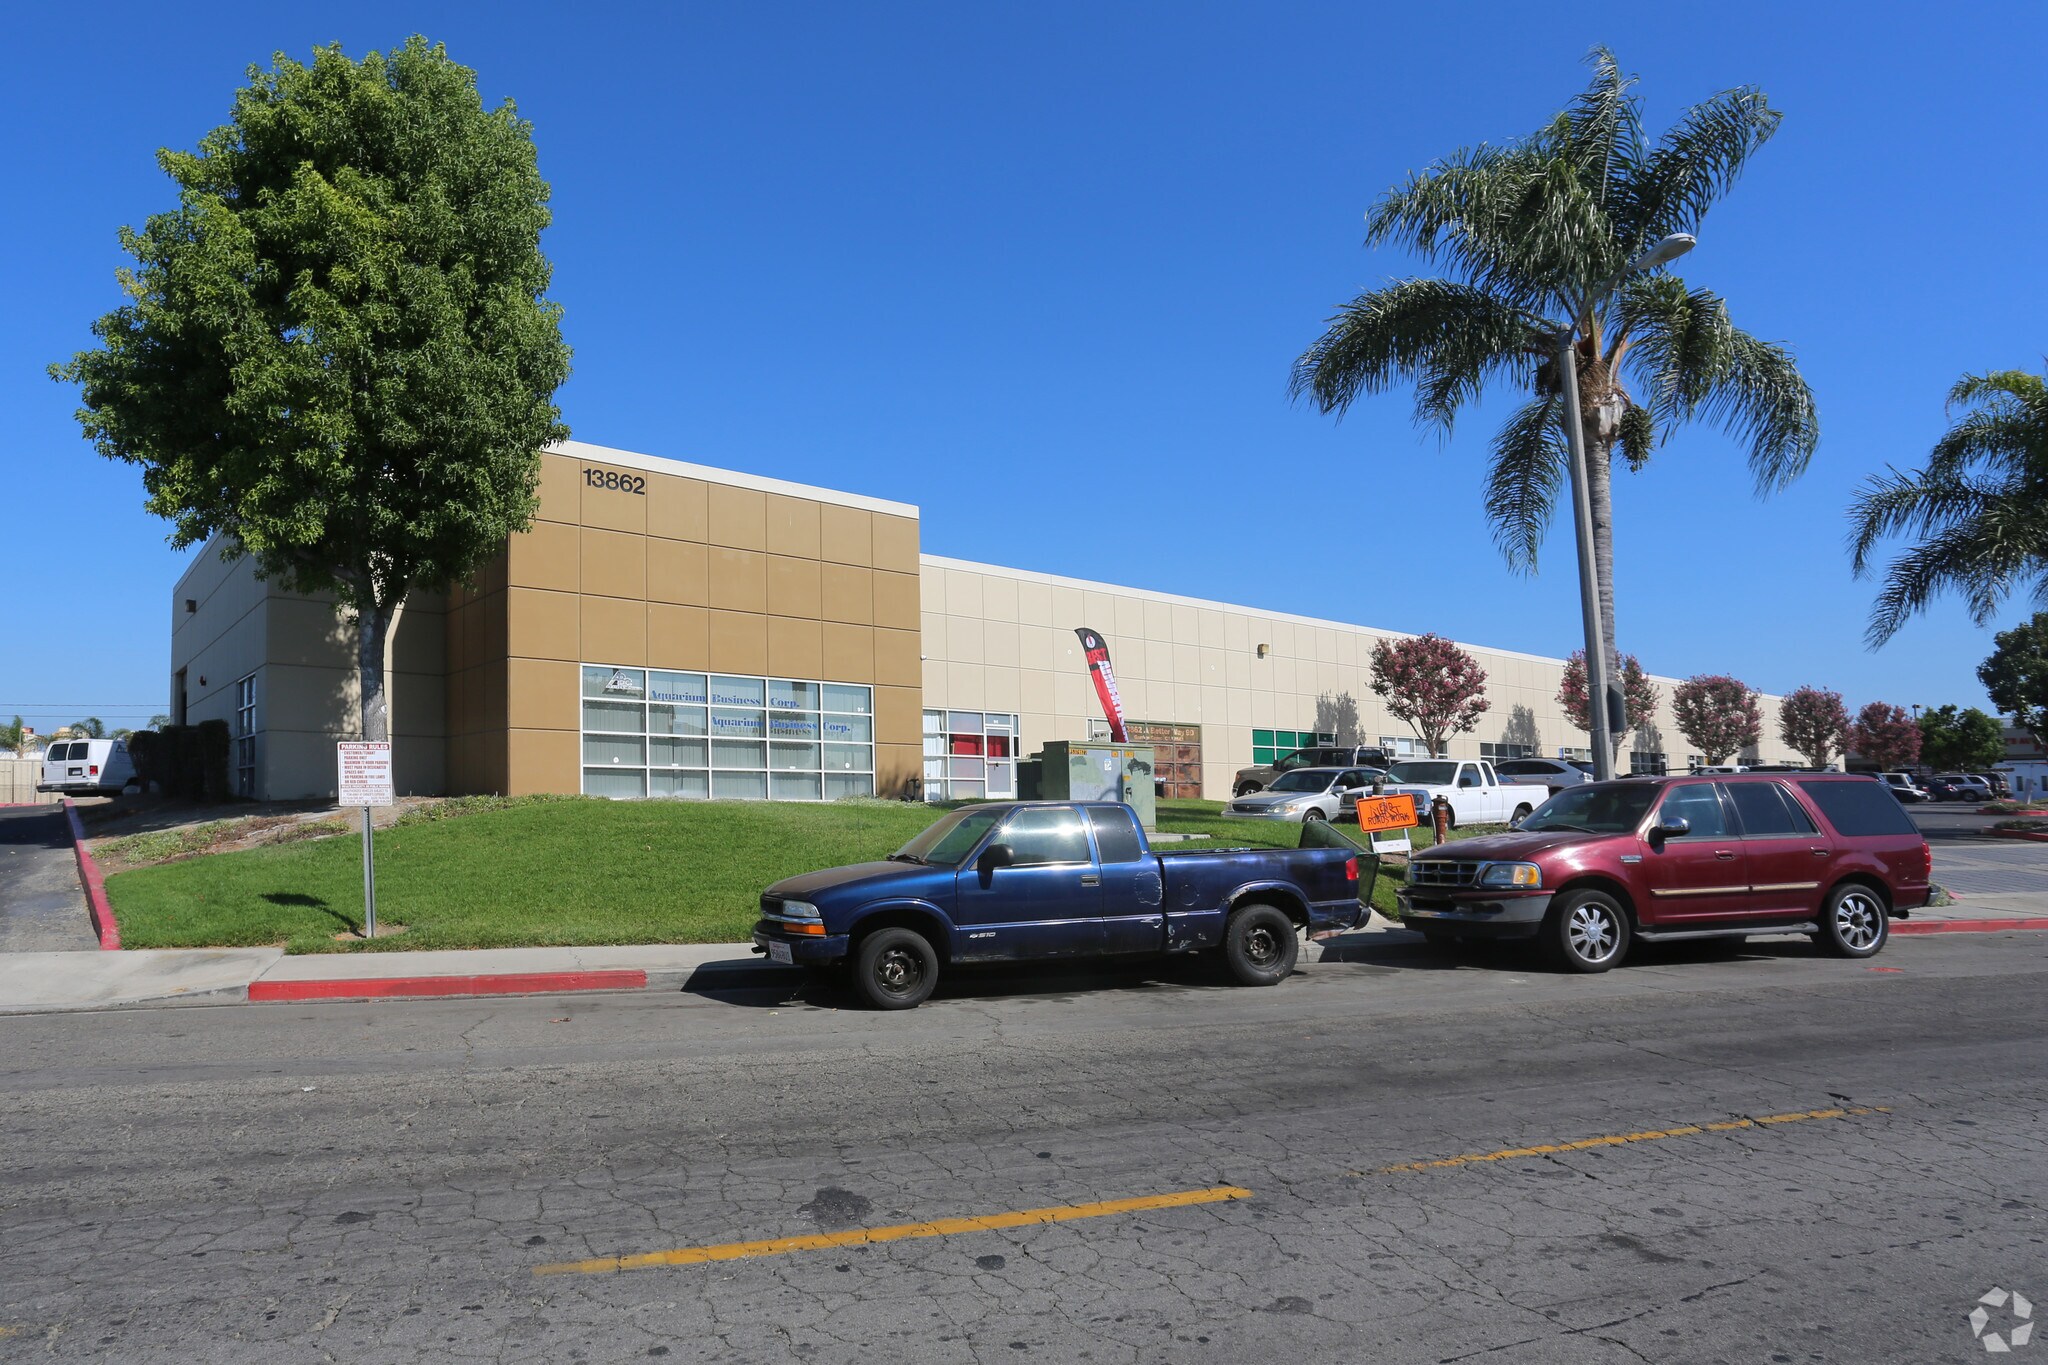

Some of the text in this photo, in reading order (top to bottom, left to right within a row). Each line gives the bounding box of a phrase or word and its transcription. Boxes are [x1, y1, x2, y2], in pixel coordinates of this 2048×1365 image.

[583, 468, 645, 495] 13862
[652, 690, 800, 708] Aquarium Business Corp.
[712, 716, 850, 732] Aquarium Business Corp.
[1150, 727, 1170, 735] Better
